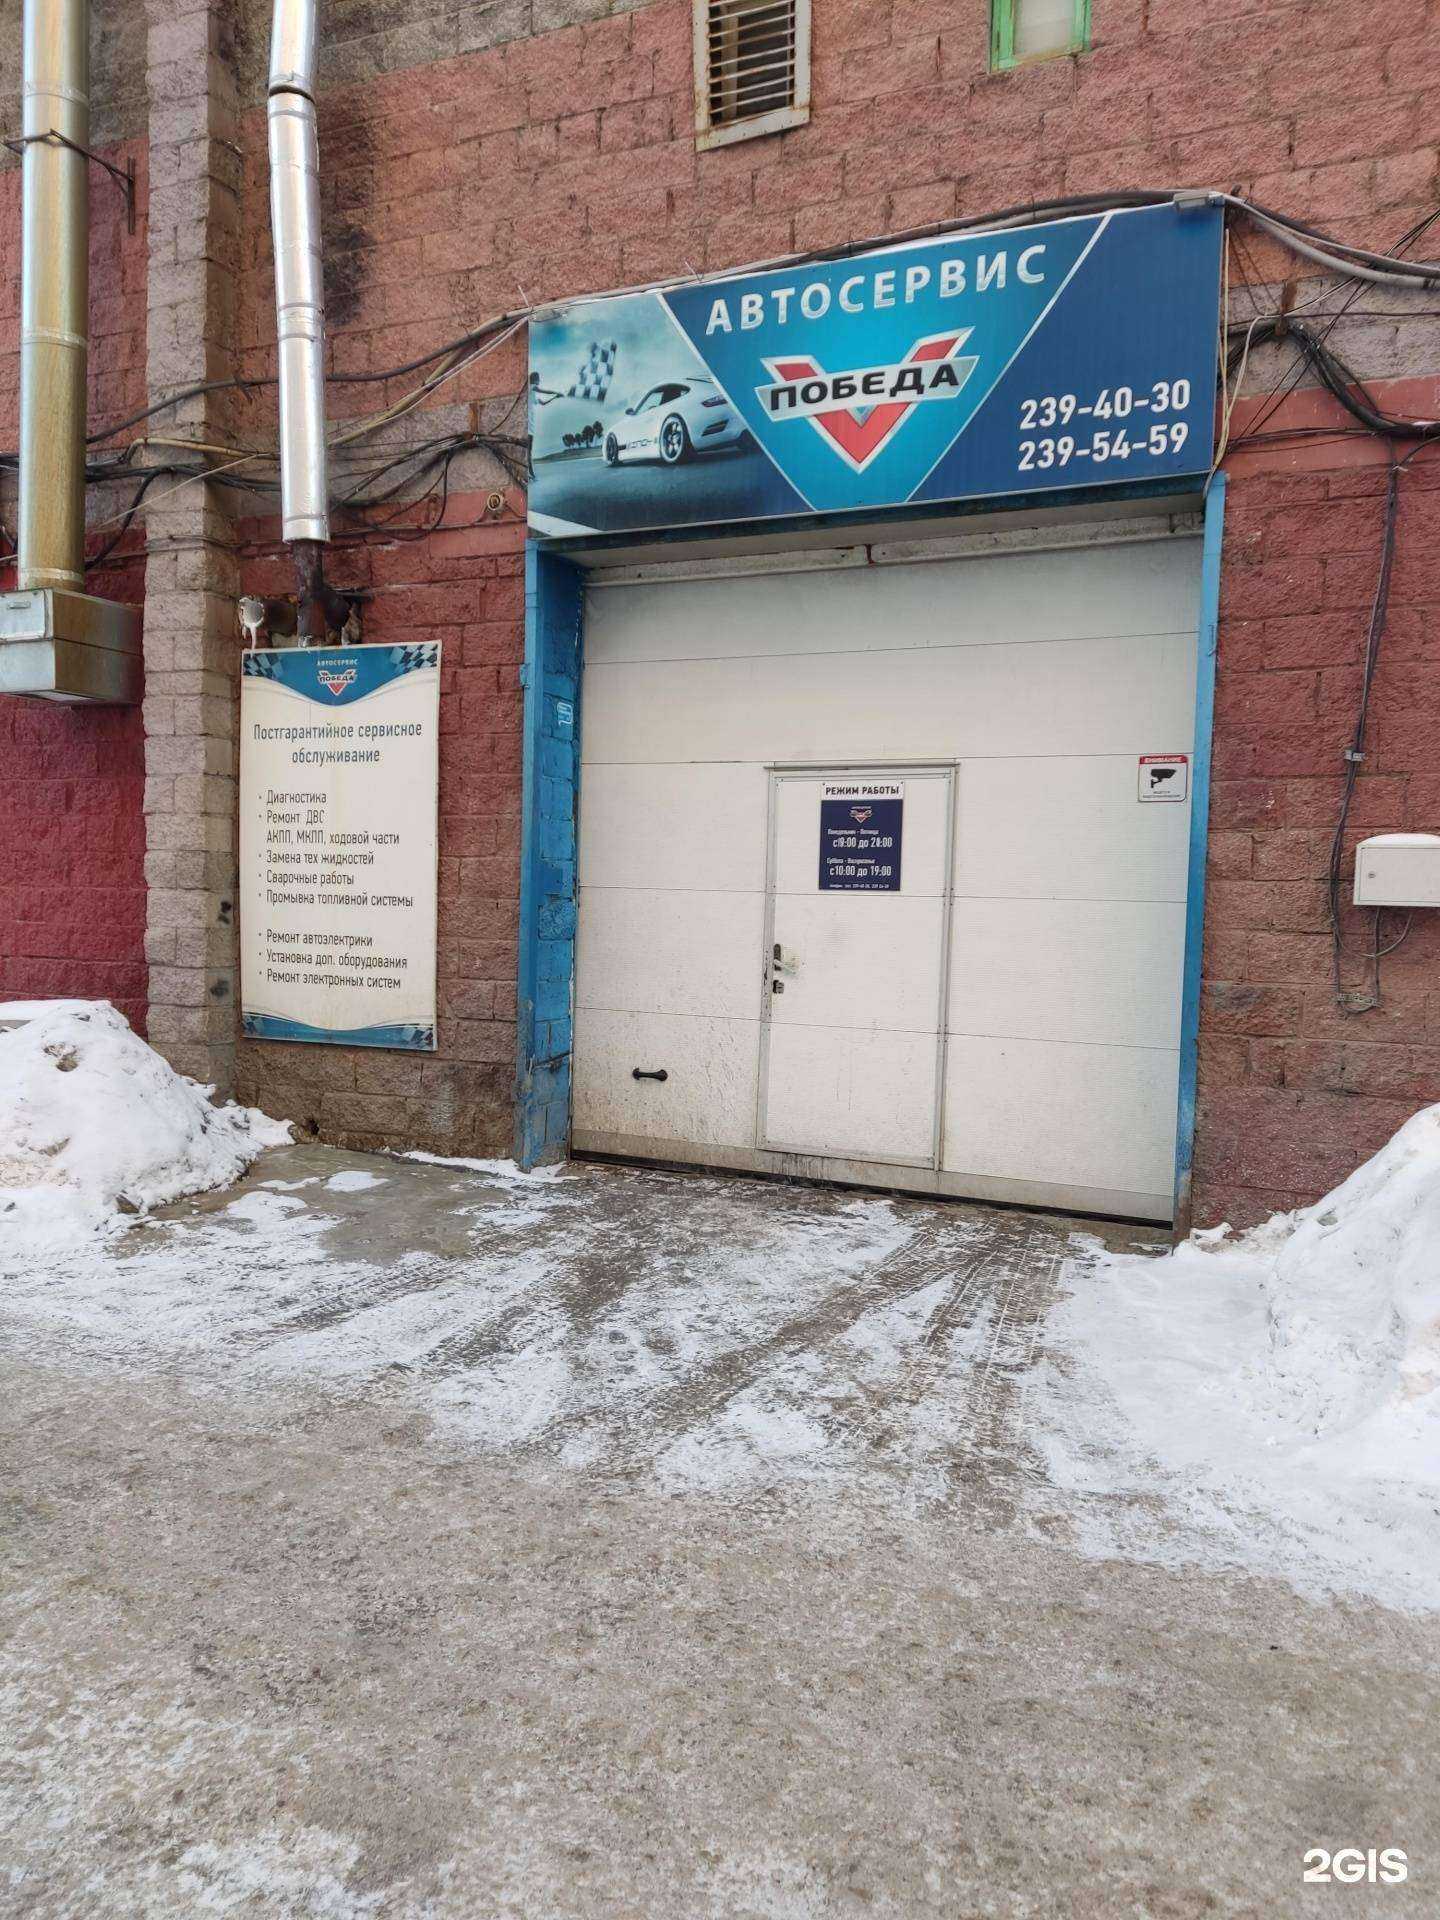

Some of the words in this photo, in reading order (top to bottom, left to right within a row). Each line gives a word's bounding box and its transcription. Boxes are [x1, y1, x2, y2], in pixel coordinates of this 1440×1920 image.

[705, 243, 1047, 336] АВТОСЕРВИС
[769, 361, 961, 412] ПОБЕДА
[1019, 378, 1191, 431] 239-40-30
[1017, 421, 1189, 472] 239-54-59
[320, 674, 354, 682] ПОБЕДА
[253, 723, 354, 743] Постгарантийное
[358, 722, 422, 741] сервисное
[292, 747, 380, 767] обслуживание
[266, 789, 327, 805] Диагностика
[825, 786, 859, 795] РЕЖИМ
[862, 785, 900, 795] РАБОТЫ
[266, 809, 300, 824] Ремонт
[305, 808, 325, 824] ДВС
[329, 831, 369, 845] ходовой
[372, 833, 400, 845] части
[266, 849, 301, 864] Замена
[304, 853, 318, 864] тех
[321, 850, 374, 866] жидкостей
[266, 869, 317, 885] Сварочные
[320, 870, 354, 886] работы
[317, 891, 368, 905] топливной
[371, 894, 413, 907] системы
[266, 928, 300, 943] Ремонт
[303, 933, 373, 949] автоэлектрики
[315, 953, 336, 966] доп.
[338, 952, 408, 970] оборудования
[267, 968, 300, 983] Ремонт
[303, 972, 364, 988] электронных
[366, 976, 401, 989] систем
